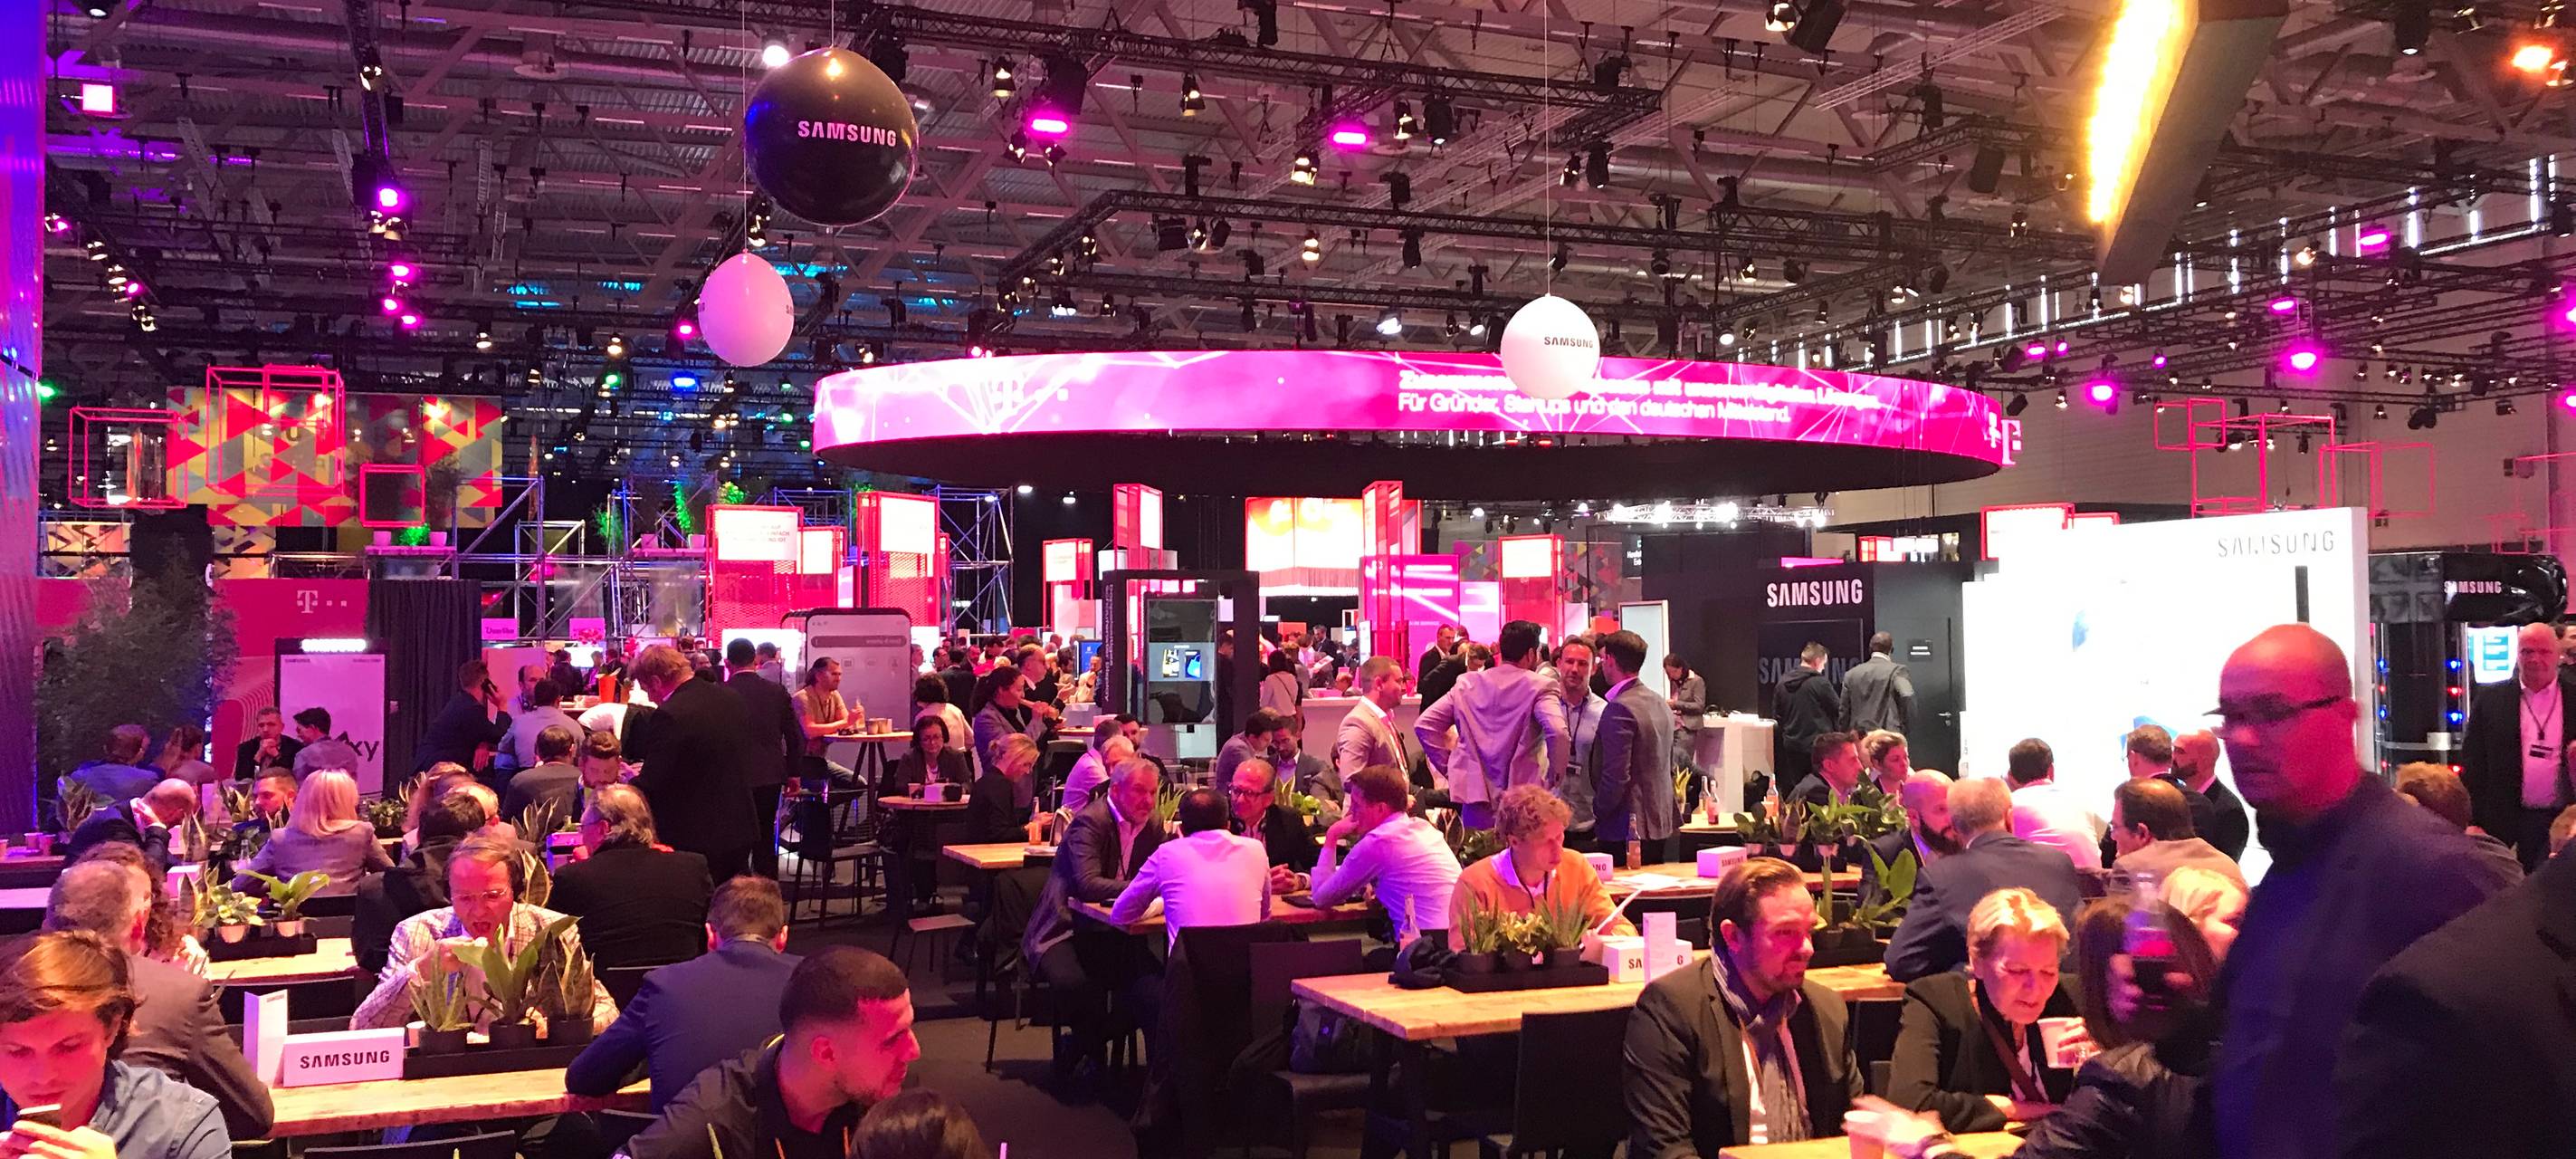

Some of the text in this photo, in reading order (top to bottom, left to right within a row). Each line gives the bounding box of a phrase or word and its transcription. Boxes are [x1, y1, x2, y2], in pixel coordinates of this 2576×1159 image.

[797, 120, 896, 147] SAMSUNG
[1544, 336, 1594, 349] SAMSUNG
[1398, 392, 1427, 411] Für
[2218, 531, 2333, 558] SAMSUNG
[1766, 579, 1863, 608] SAMSUNG
[2444, 580, 2502, 594] SAMSUNG
[300, 1050, 390, 1069] SAMSUNG
